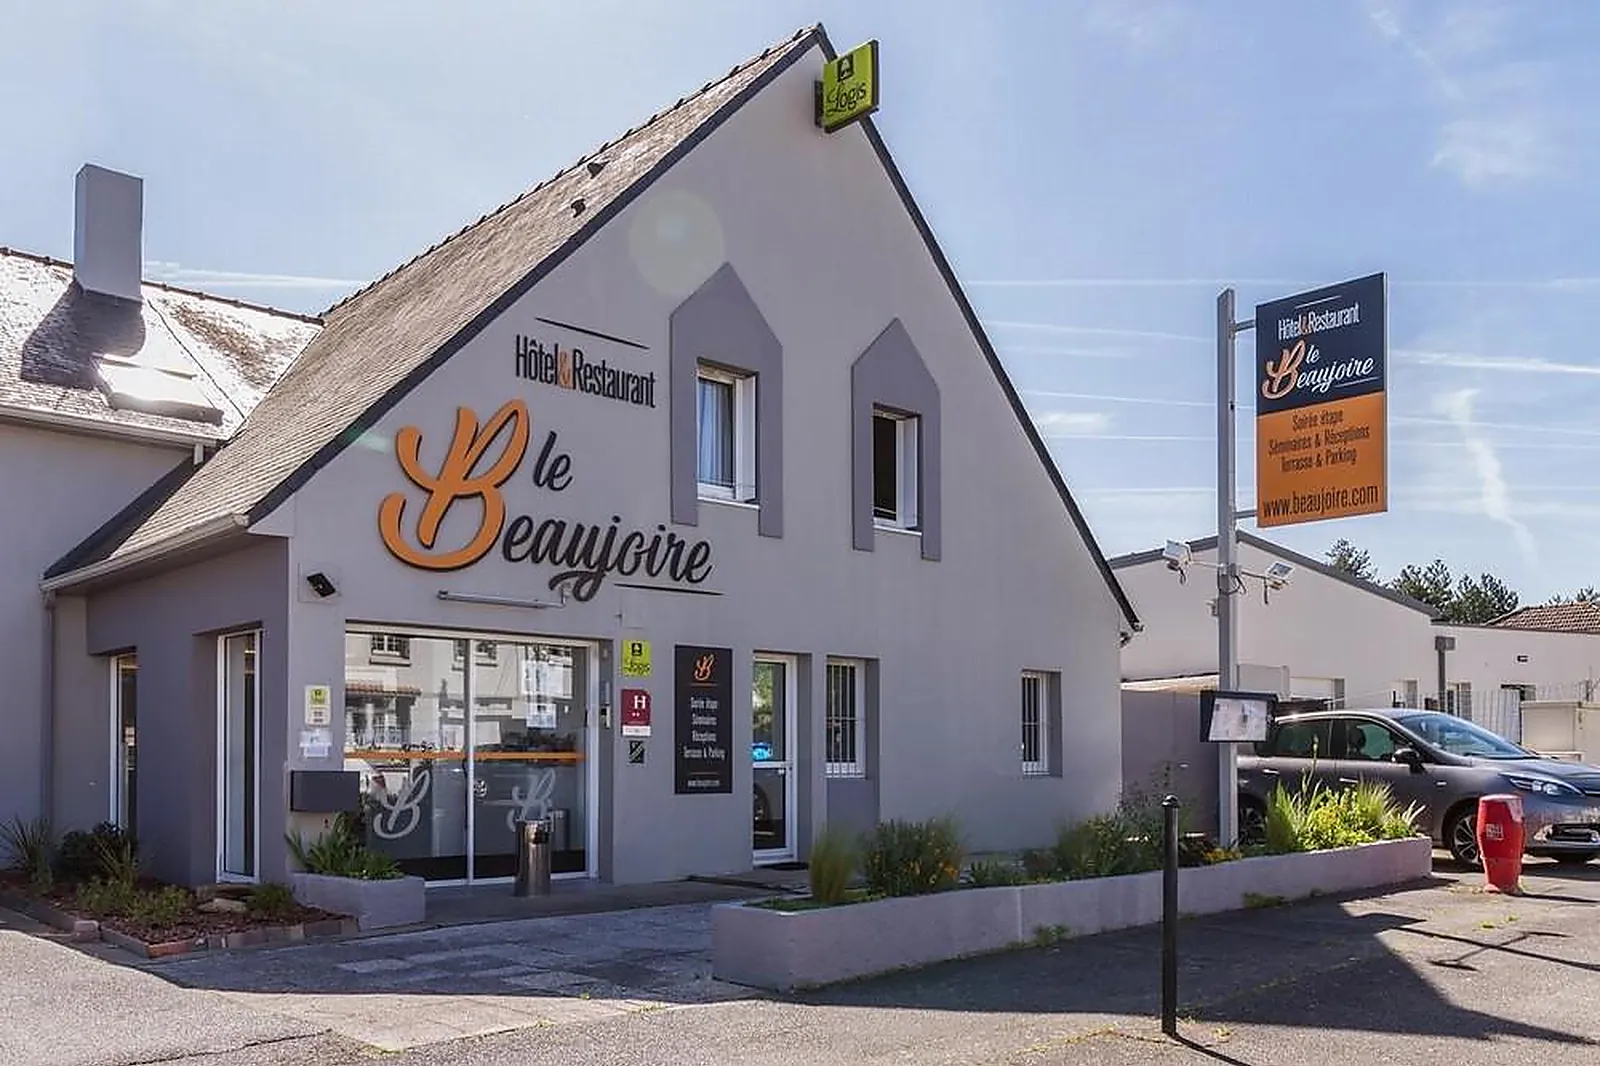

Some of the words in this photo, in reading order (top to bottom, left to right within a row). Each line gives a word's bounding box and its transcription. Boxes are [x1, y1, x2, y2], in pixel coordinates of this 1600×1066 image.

[1305, 344, 1320, 364] le
[1262, 339, 1375, 399] Beaujoire
[1314, 433, 1321, 448] &
[533, 430, 574, 492] le
[1315, 453, 1323, 468] &
[1326, 447, 1357, 468] Parking
[378, 398, 713, 602] Beaujoire
[1262, 483, 1379, 519] www.beaujoire.com
[634, 694, 646, 710] H
